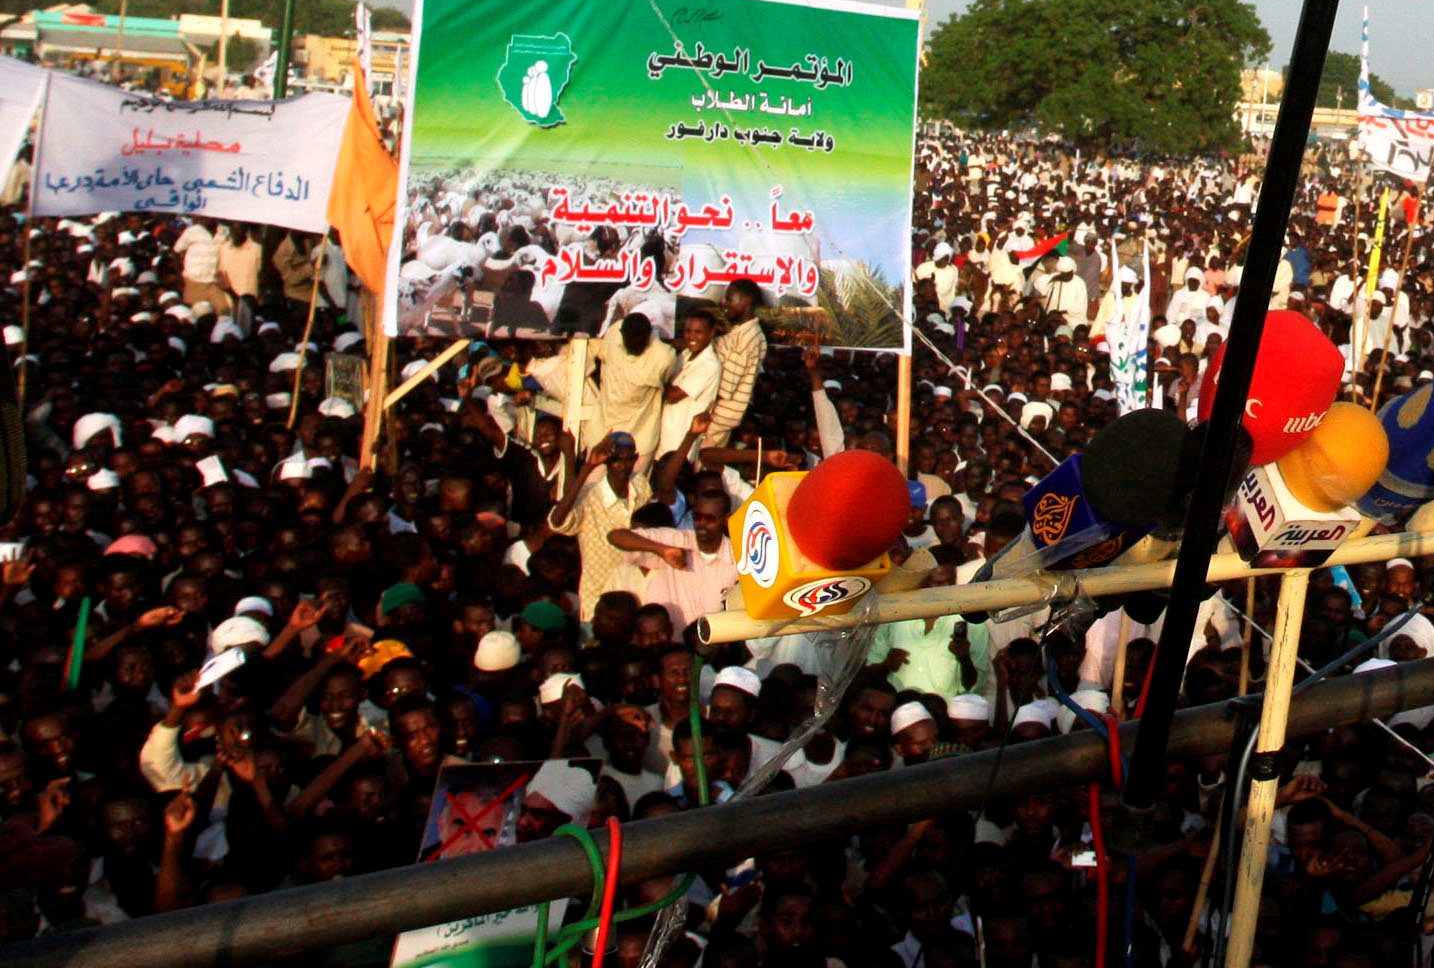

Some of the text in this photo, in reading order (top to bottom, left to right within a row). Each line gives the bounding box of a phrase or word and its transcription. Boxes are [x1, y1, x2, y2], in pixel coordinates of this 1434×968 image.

[647, 40, 853, 90] المؤتمر الوطني
[691, 89, 755, 111] الطلاب
[173, 129, 242, 156] محلية
[665, 121, 835, 151] ولاية جنوب دارفور
[251, 171, 310, 201] الدفاع
[551, 187, 671, 234] التنمية
[672, 194, 734, 235] نحو
[540, 248, 657, 291] والسلام
[1242, 473, 1276, 532] العربي
[1275, 525, 1345, 546] العربية
